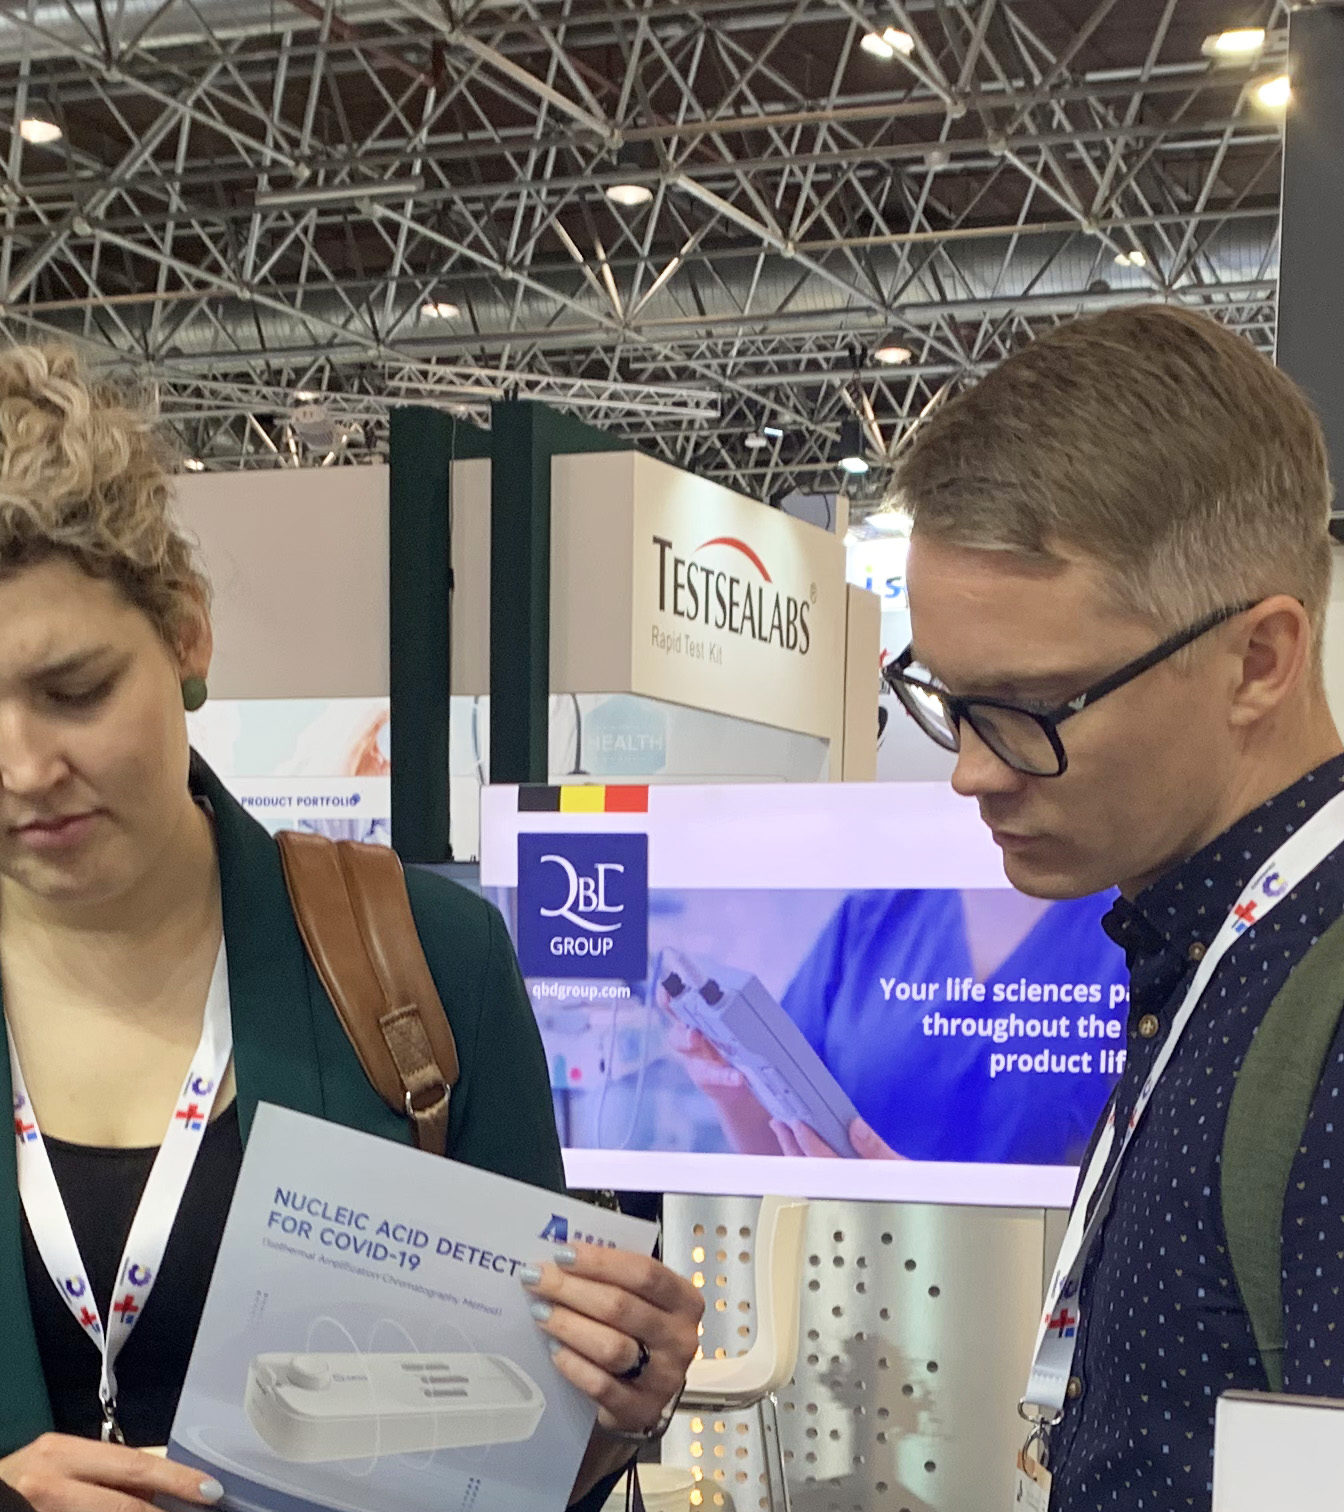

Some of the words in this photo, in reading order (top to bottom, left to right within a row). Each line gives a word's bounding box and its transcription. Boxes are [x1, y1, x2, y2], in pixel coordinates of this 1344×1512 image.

[652, 625, 682, 655] Rapid
[685, 634, 705, 660] Test
[709, 640, 722, 665] Kit
[588, 735, 663, 752] HEALTH
[241, 796, 293, 808] PRODUCT
[296, 796, 357, 808] PORTFOLIO
[550, 936, 614, 956] GROUP
[532, 982, 631, 1001] qbdgroup.com
[879, 977, 940, 1002] Your
[946, 977, 986, 1002] life
[992, 978, 1102, 1003] sciences
[922, 1012, 1070, 1043] throughout
[1077, 1014, 1122, 1039] the
[989, 1049, 1092, 1078] product
[267, 1210, 313, 1240] FOR
[319, 1227, 422, 1272] COVID-19
[273, 1186, 370, 1231] NUCLEIC
[375, 1219, 430, 1249] ACID
[434, 1237, 526, 1278] DETECT
